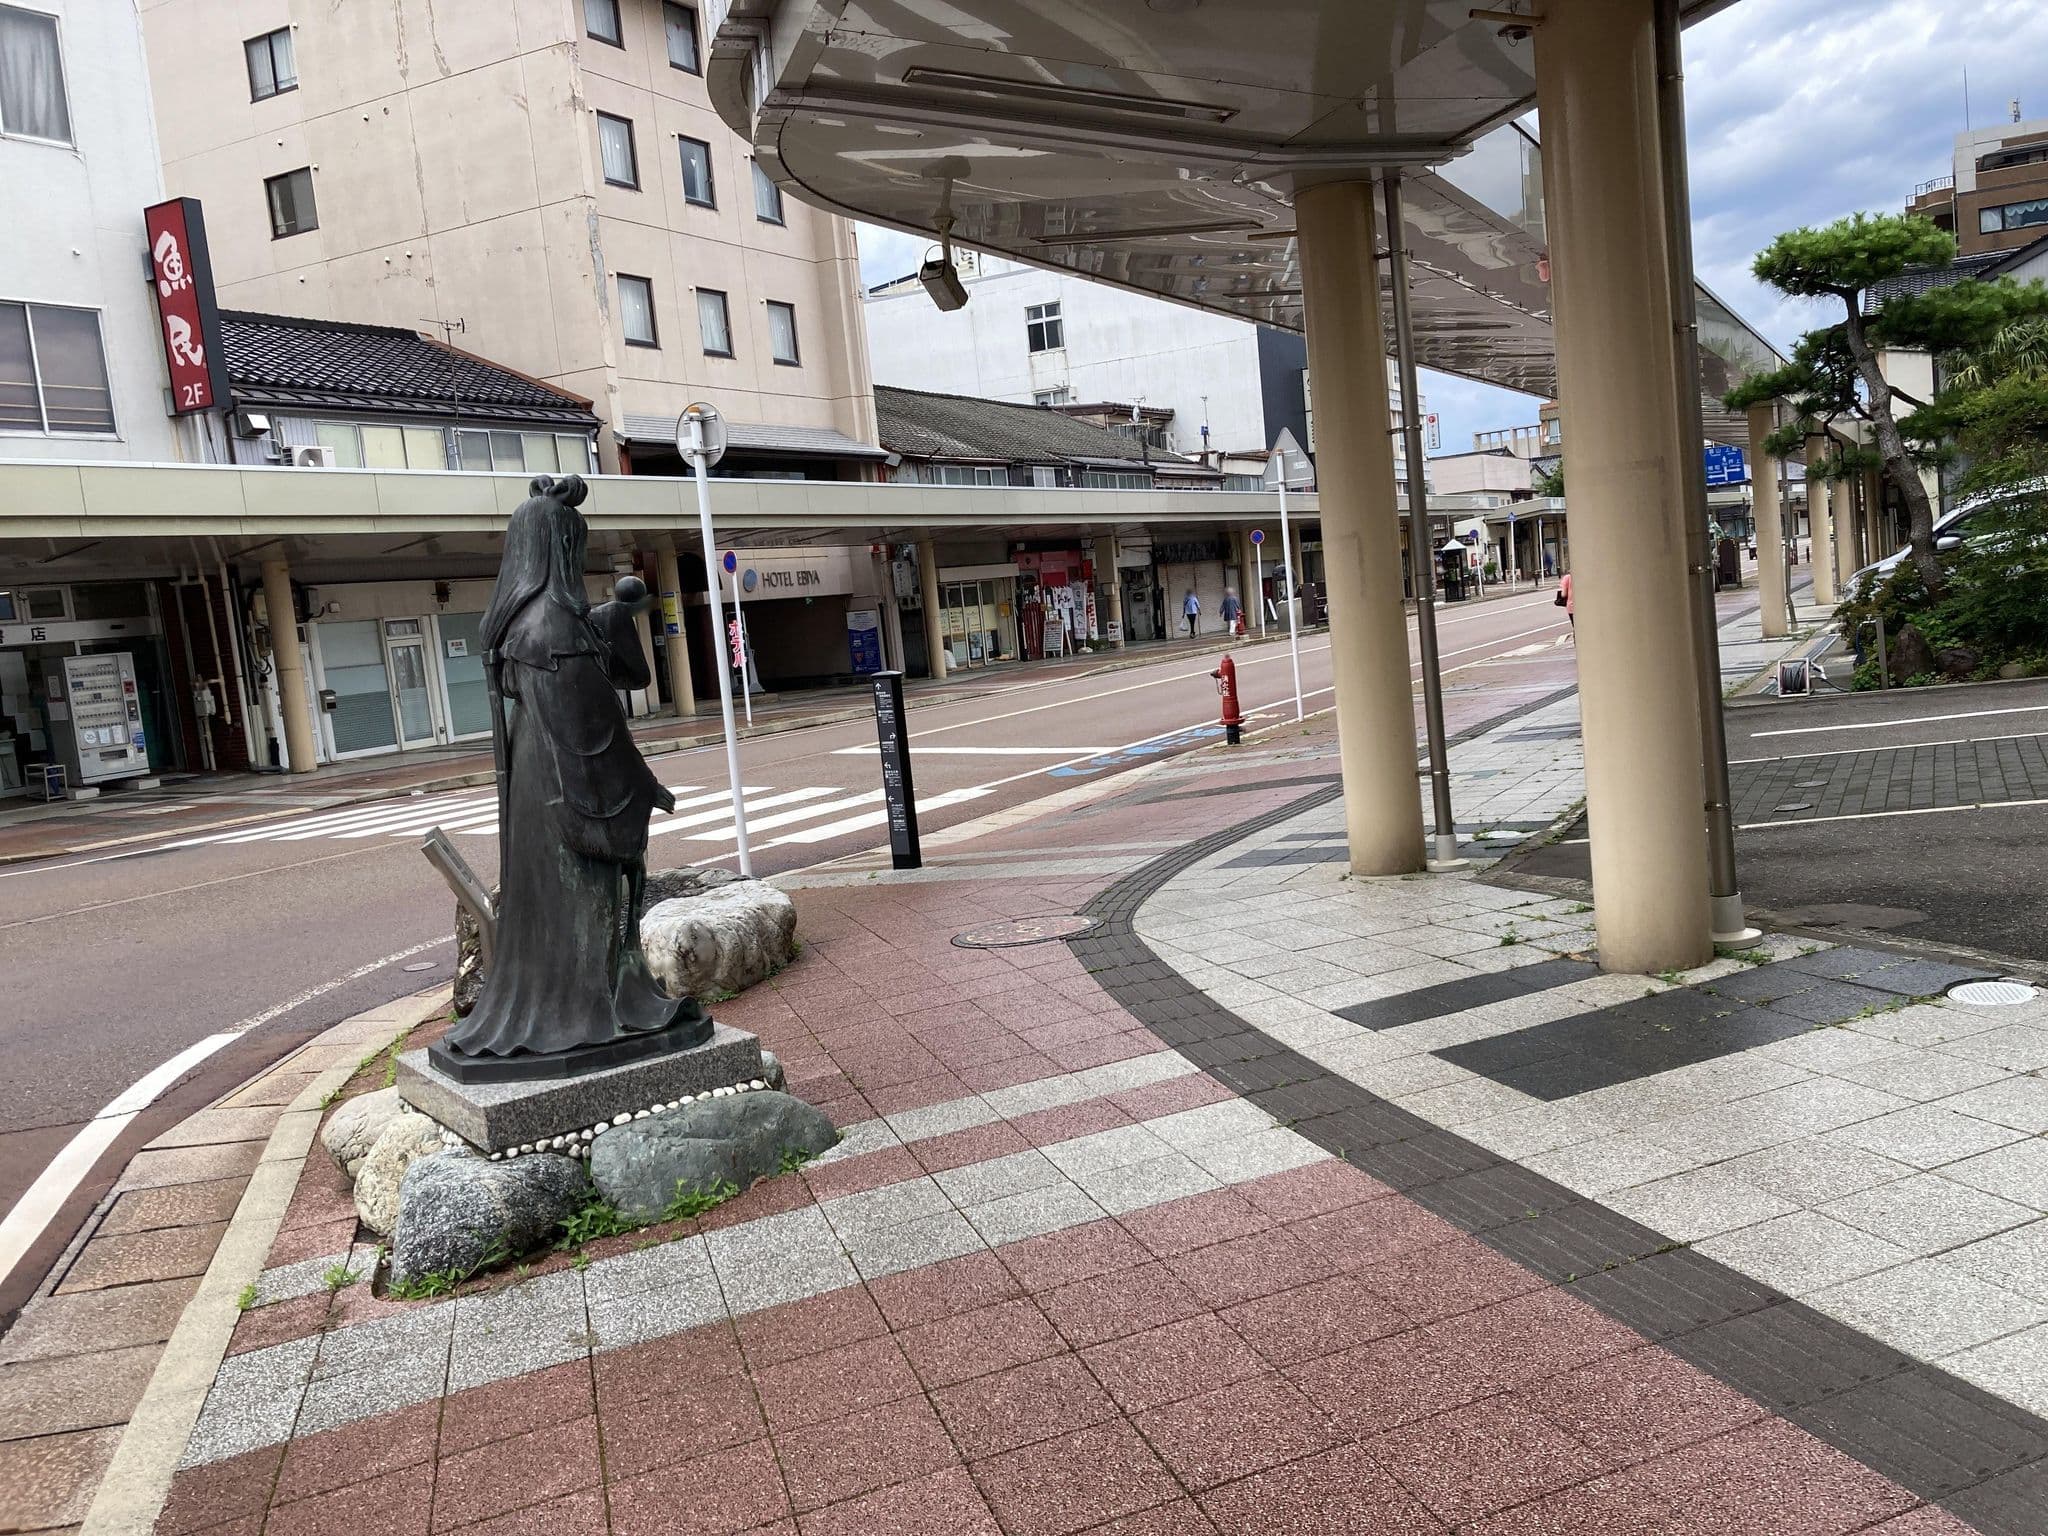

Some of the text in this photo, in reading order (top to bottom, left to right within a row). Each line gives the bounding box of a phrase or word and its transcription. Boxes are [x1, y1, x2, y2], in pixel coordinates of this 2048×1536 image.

[154, 230, 204, 367] 魚民
[182, 382, 204, 407] 2F
[761, 569, 820, 588] HOTEL EBIYA
